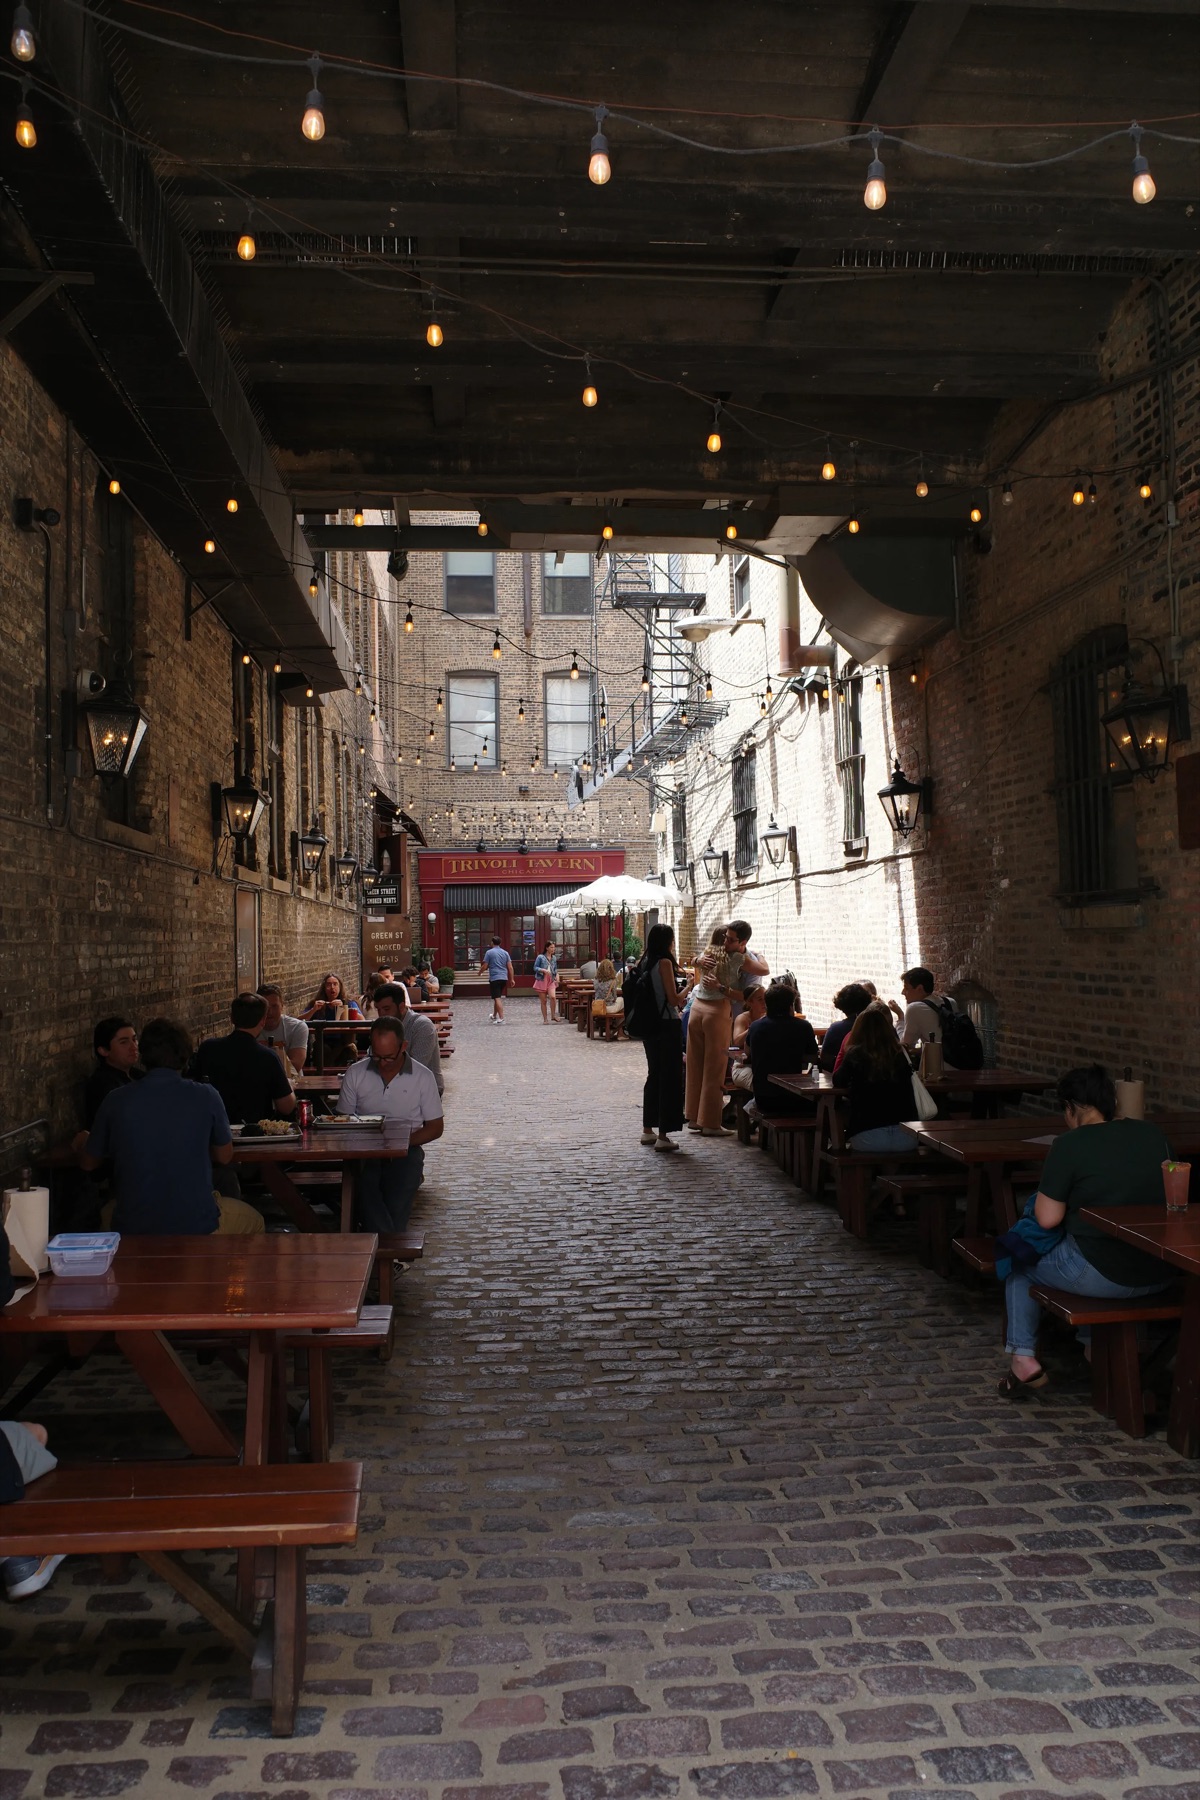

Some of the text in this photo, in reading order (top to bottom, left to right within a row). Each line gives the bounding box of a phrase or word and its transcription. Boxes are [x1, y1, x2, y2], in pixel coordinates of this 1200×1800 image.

[448, 858, 595, 874] TRIVOLI TAVERN
[395, 931, 404, 939] ST
[374, 943, 401, 951] SMOKED
[376, 955, 399, 963] MEATS
